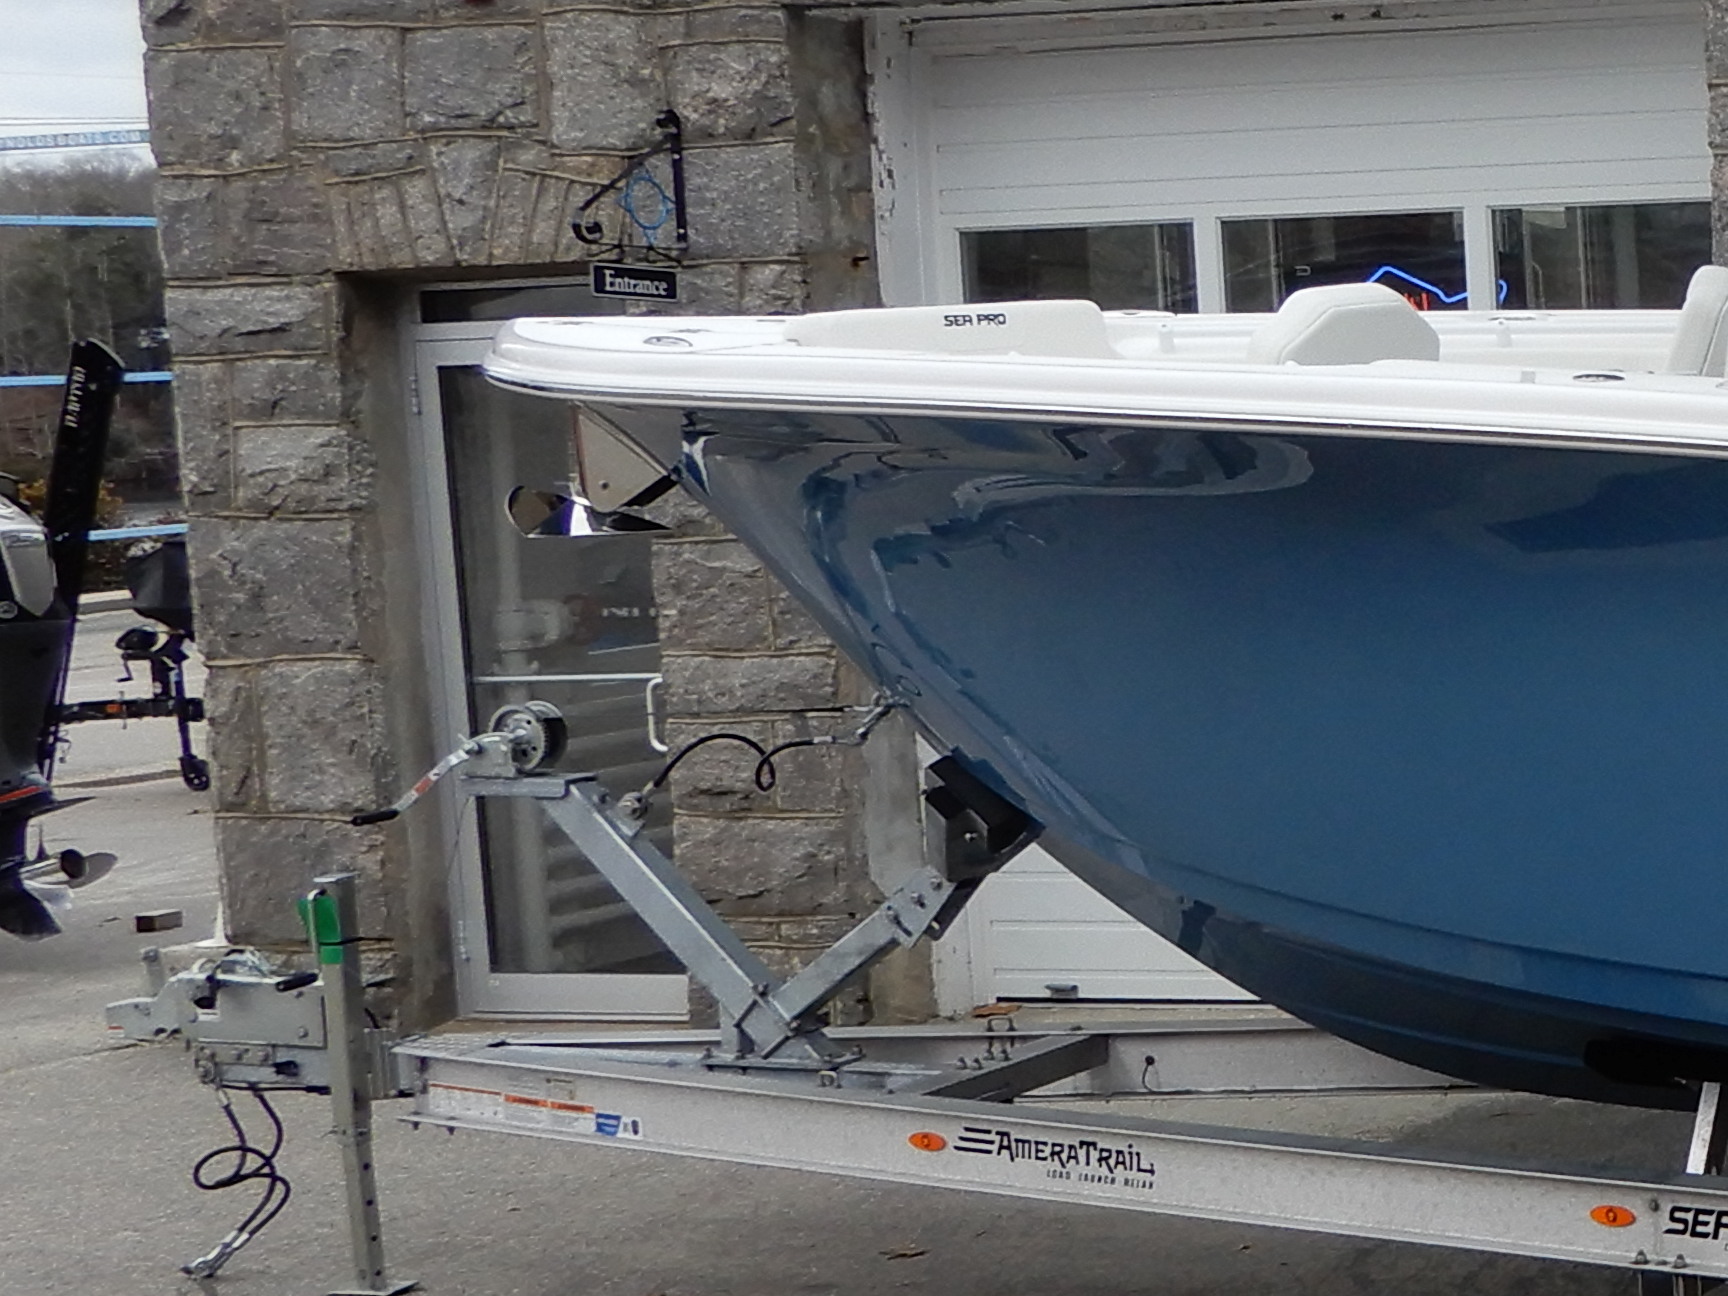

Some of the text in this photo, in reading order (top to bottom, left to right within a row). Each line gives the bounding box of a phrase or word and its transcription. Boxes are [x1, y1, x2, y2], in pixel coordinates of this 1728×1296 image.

[603, 268, 669, 296] Entrance
[943, 312, 1007, 327] SEA PRO
